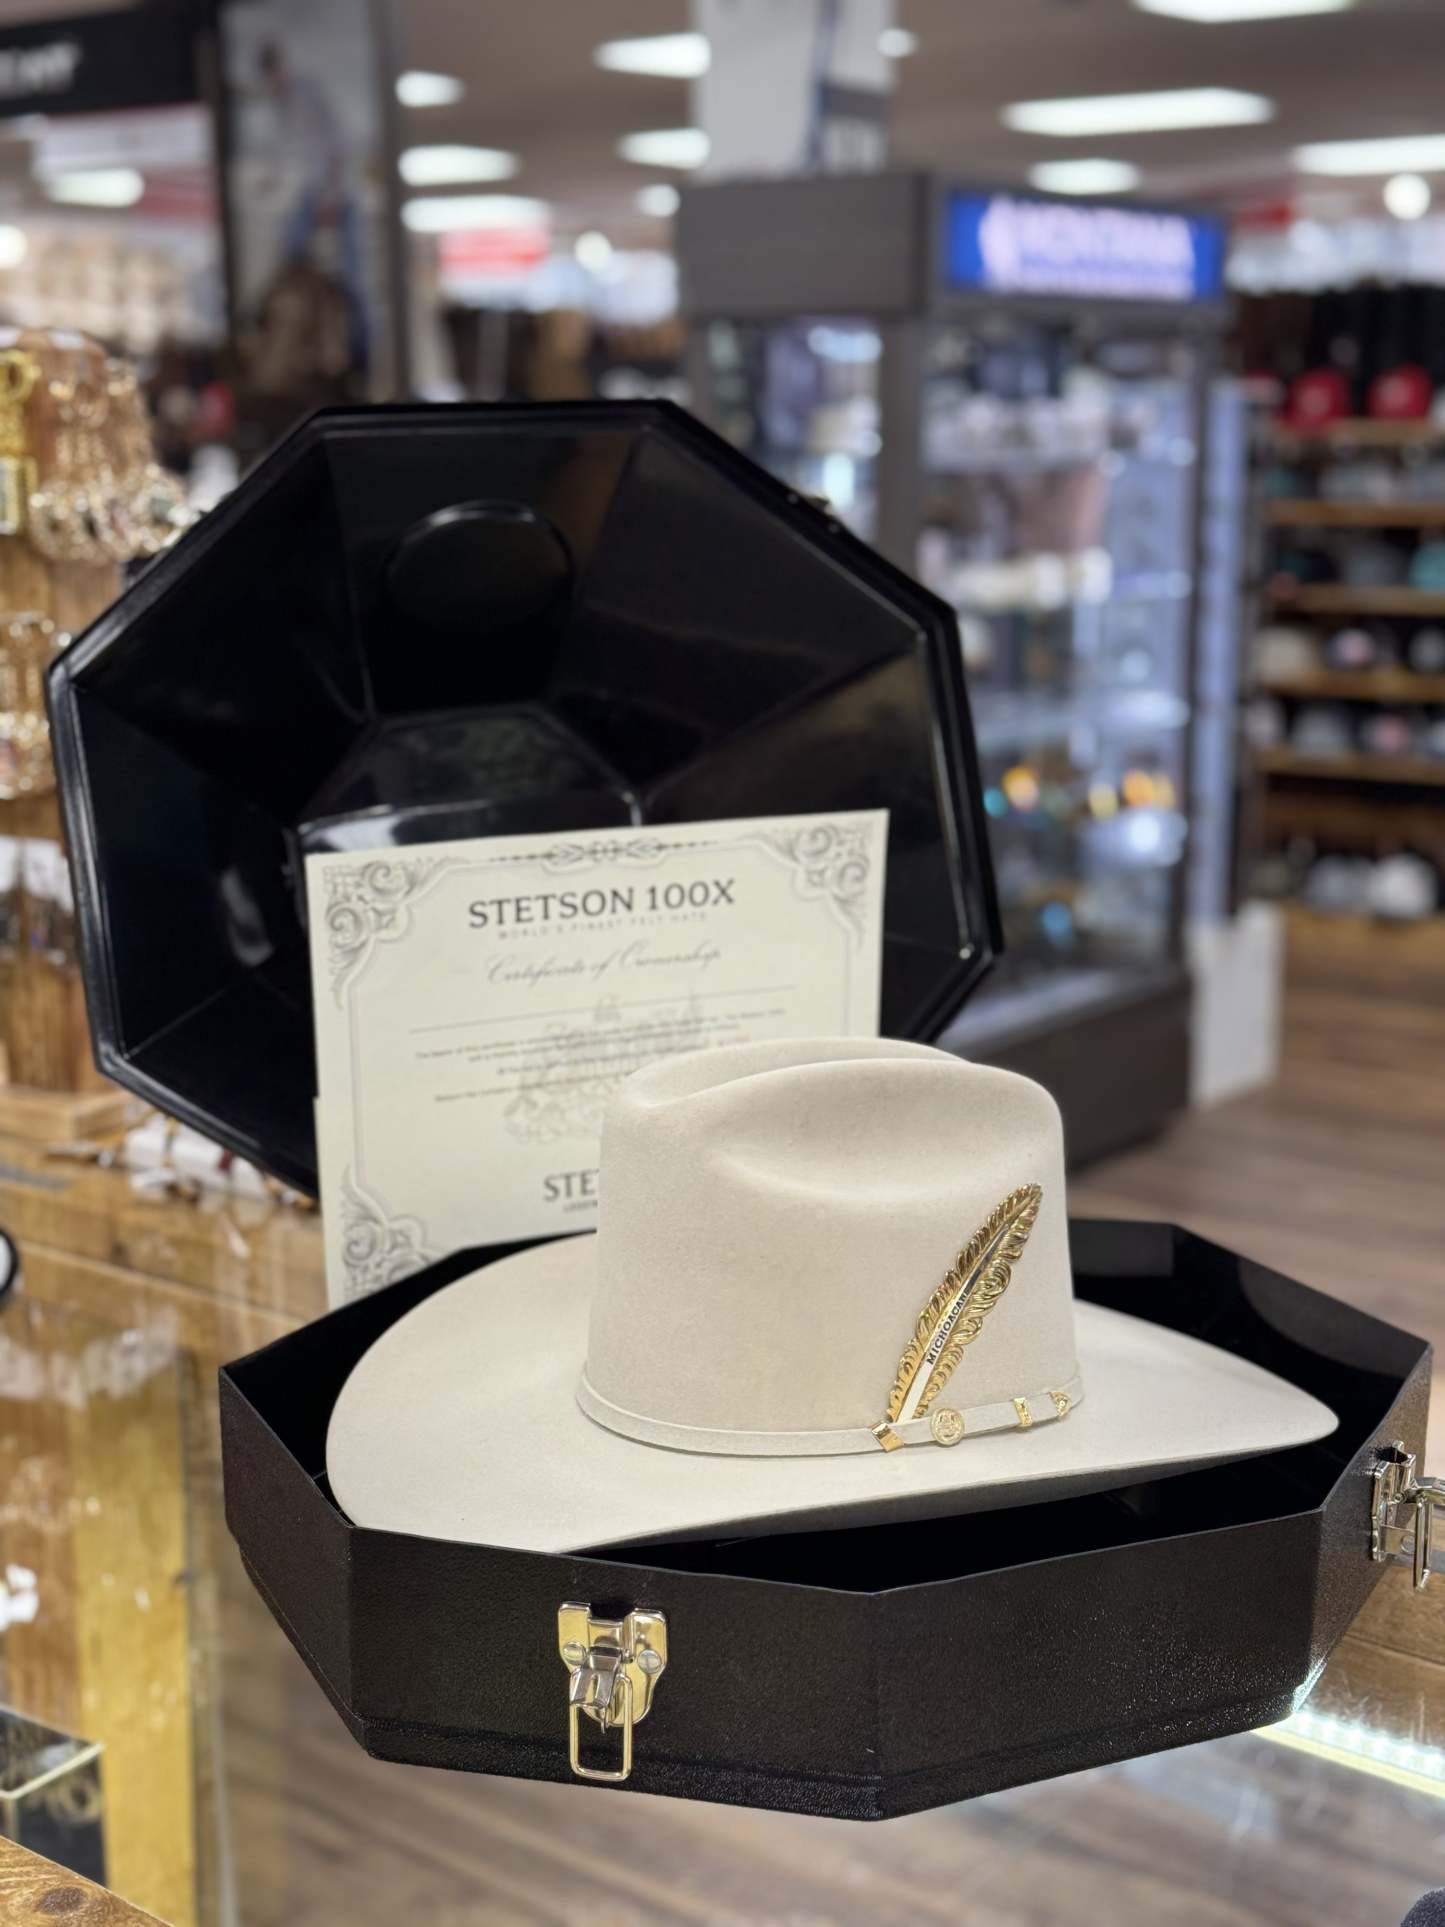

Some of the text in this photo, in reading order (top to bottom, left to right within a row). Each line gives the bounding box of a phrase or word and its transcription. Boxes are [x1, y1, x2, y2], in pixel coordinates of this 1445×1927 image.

[468, 878, 735, 928] STETSON 100X
[543, 1169, 599, 1202] STE
